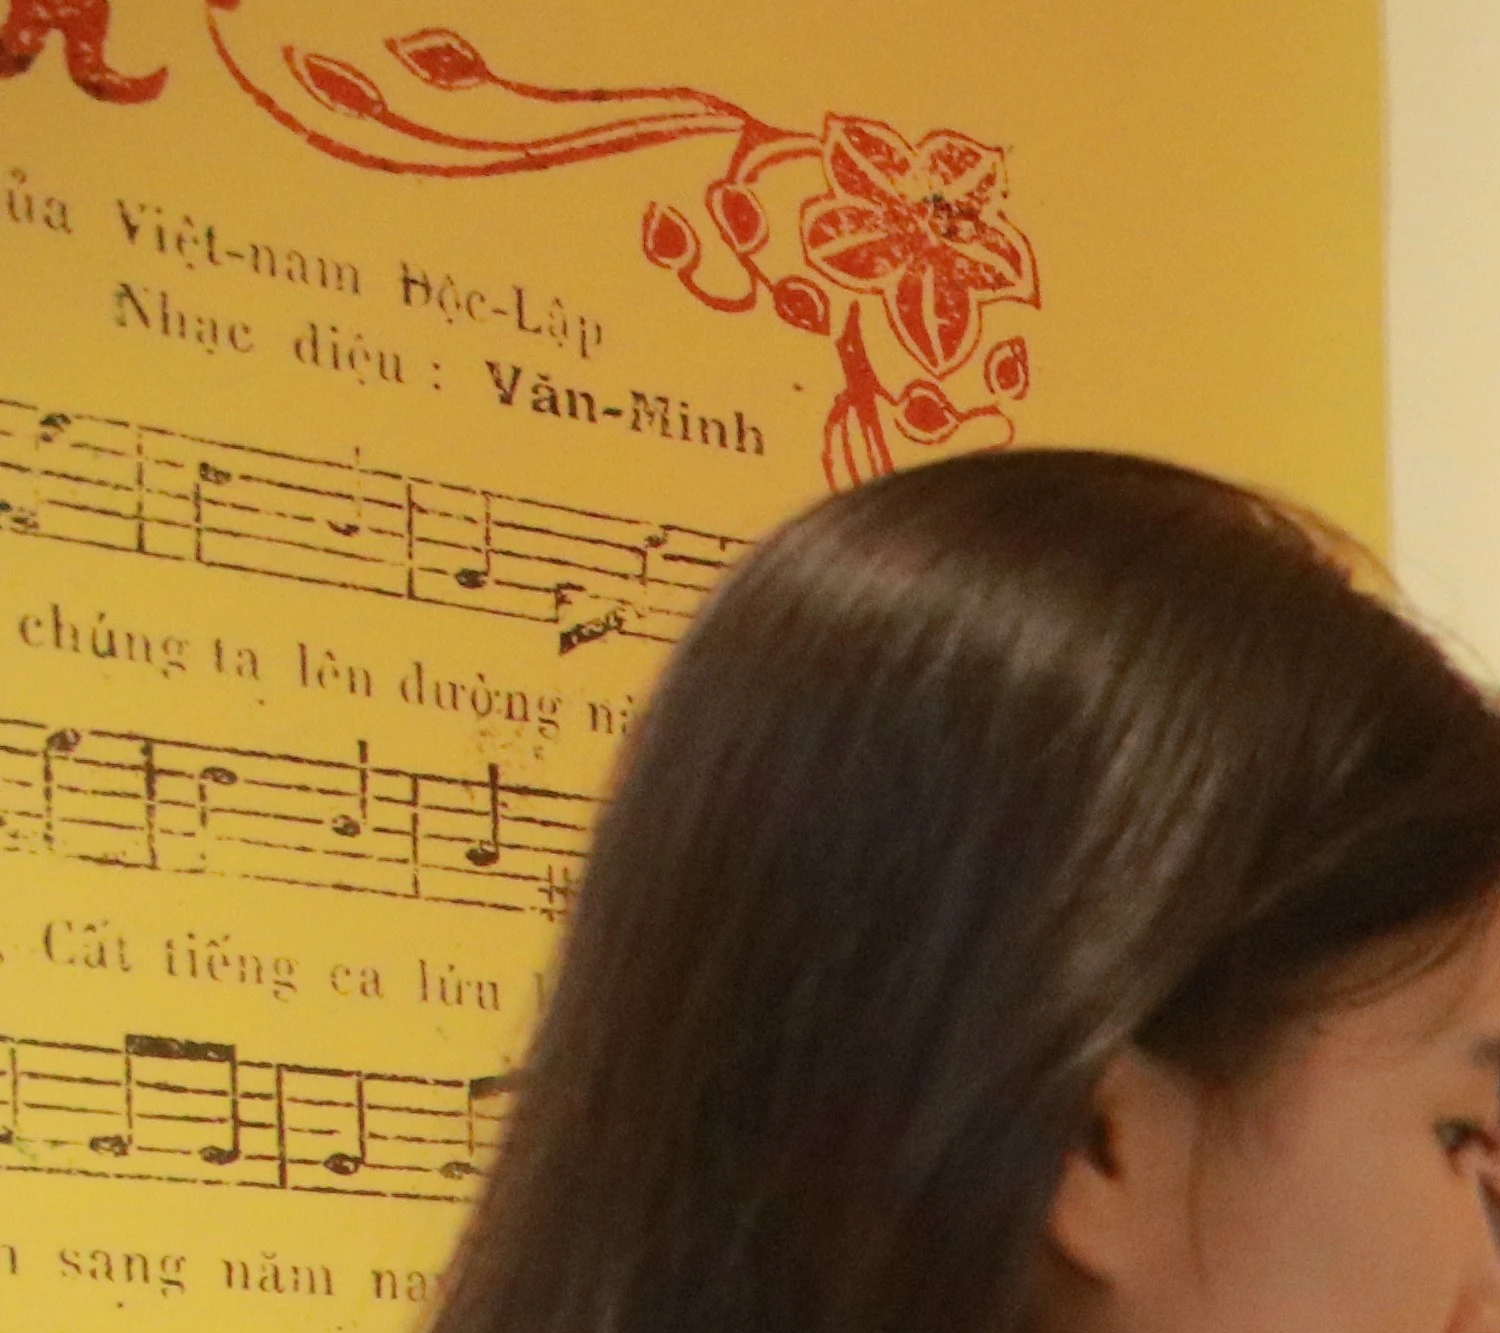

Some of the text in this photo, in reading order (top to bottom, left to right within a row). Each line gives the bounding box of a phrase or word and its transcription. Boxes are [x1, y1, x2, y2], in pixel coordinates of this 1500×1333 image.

[116, 198, 603, 360] Việt-nam Độc-Lập
[114, 282, 766, 457] Nhạc Văn-Minh
[298, 641, 372, 698] lên
[329, 962, 385, 1000] ca
[221, 1250, 335, 1297] năm
